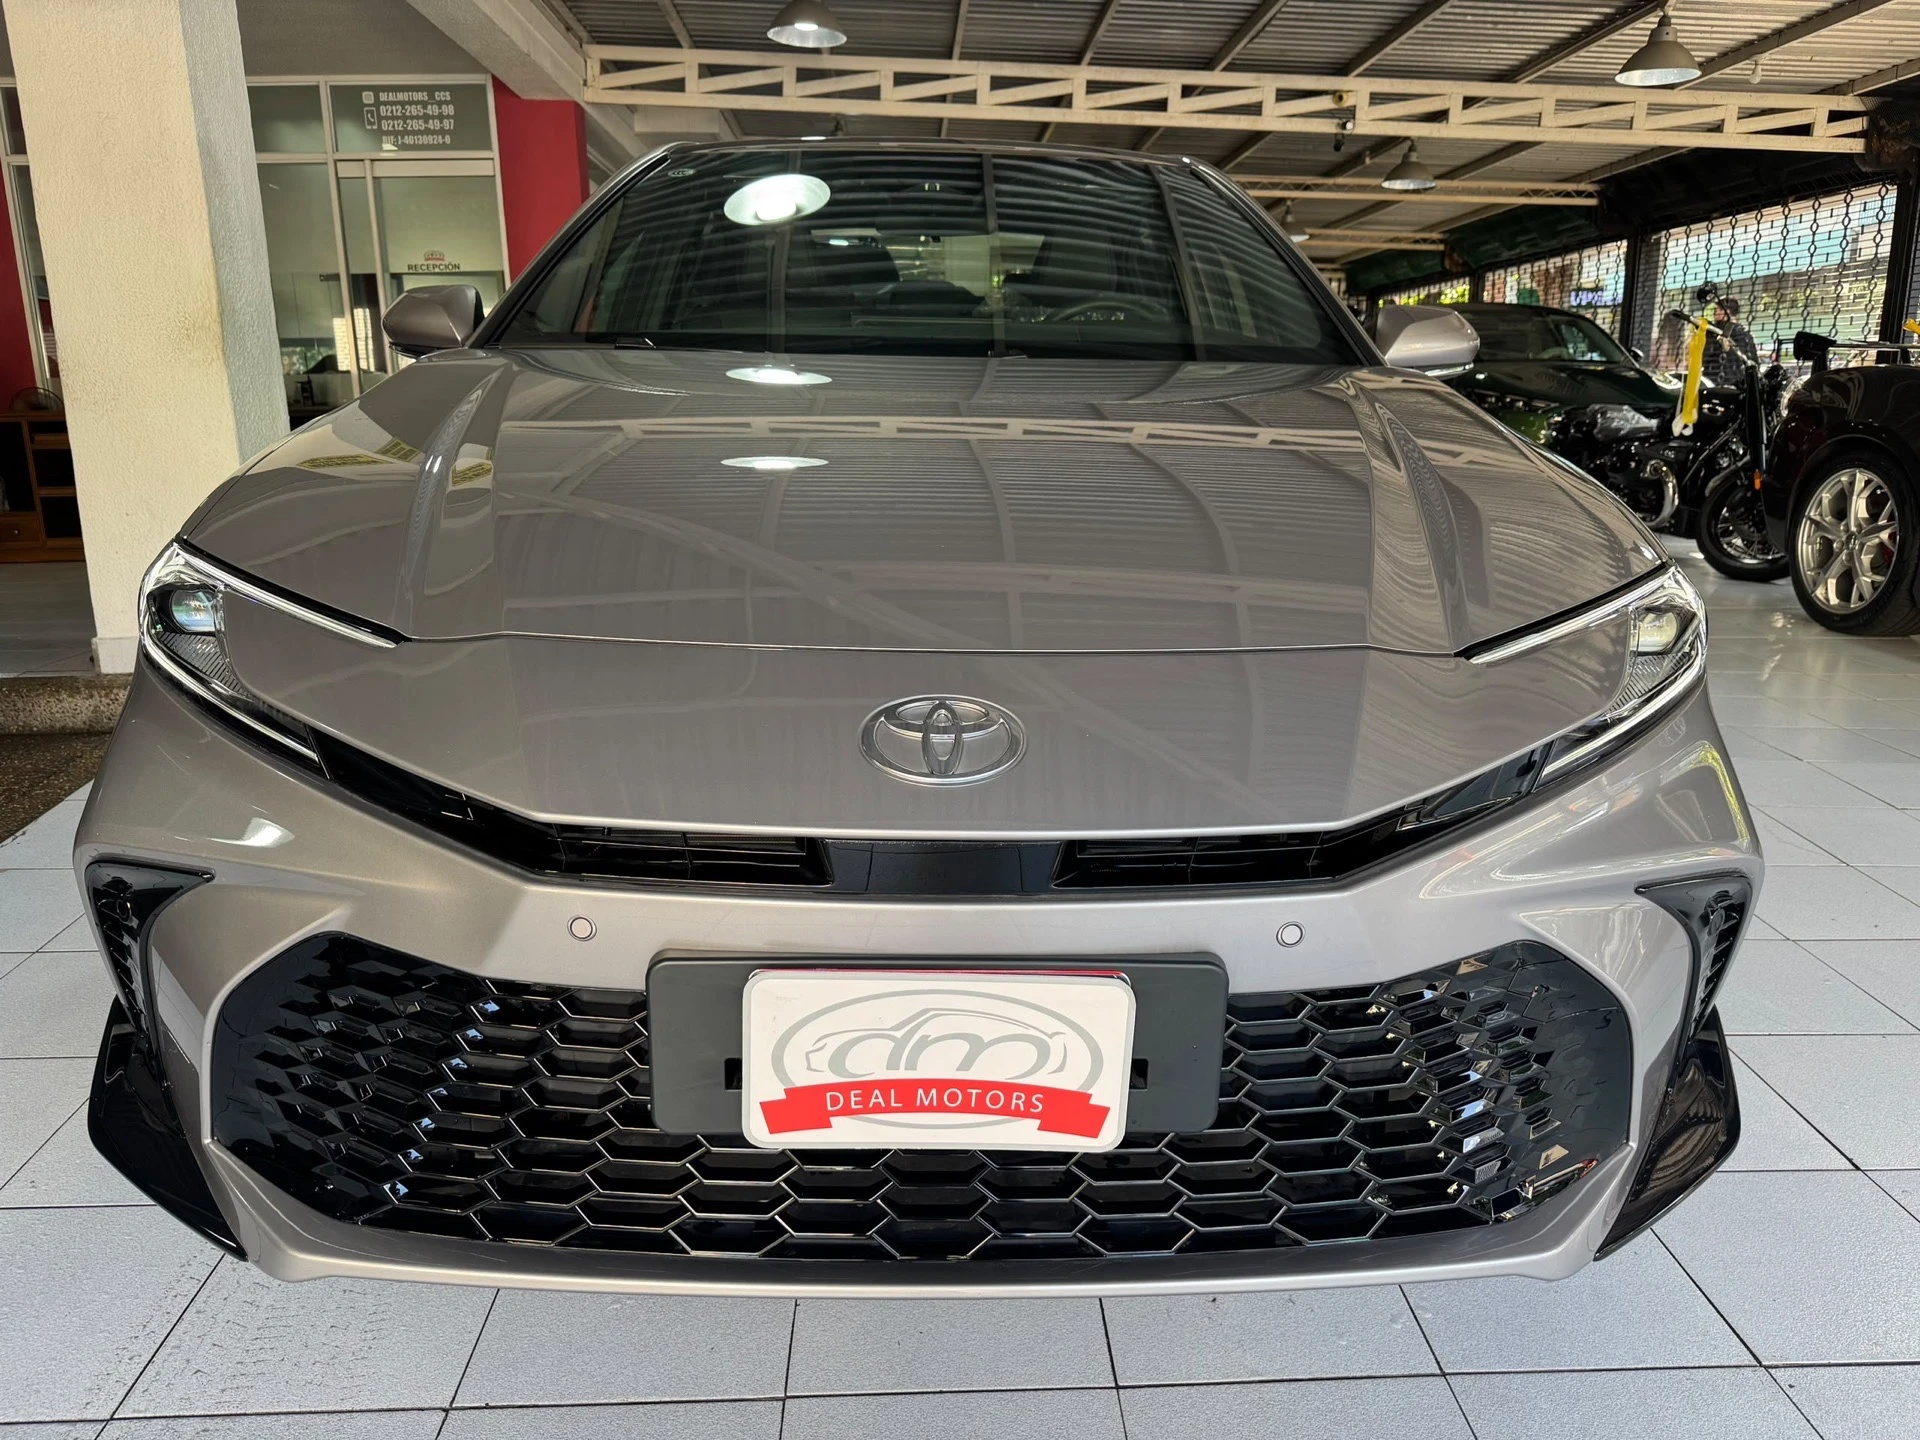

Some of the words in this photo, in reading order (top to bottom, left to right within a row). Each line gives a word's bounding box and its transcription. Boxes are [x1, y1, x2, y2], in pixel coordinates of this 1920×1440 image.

[380, 104, 455, 116] 0212-265-49-98
[381, 119, 455, 131] 0212-265-49-97
[407, 261, 460, 271] RECEPCIÓN
[825, 1088, 902, 1111] DEAL
[916, 1087, 1044, 1112] MOTORS
